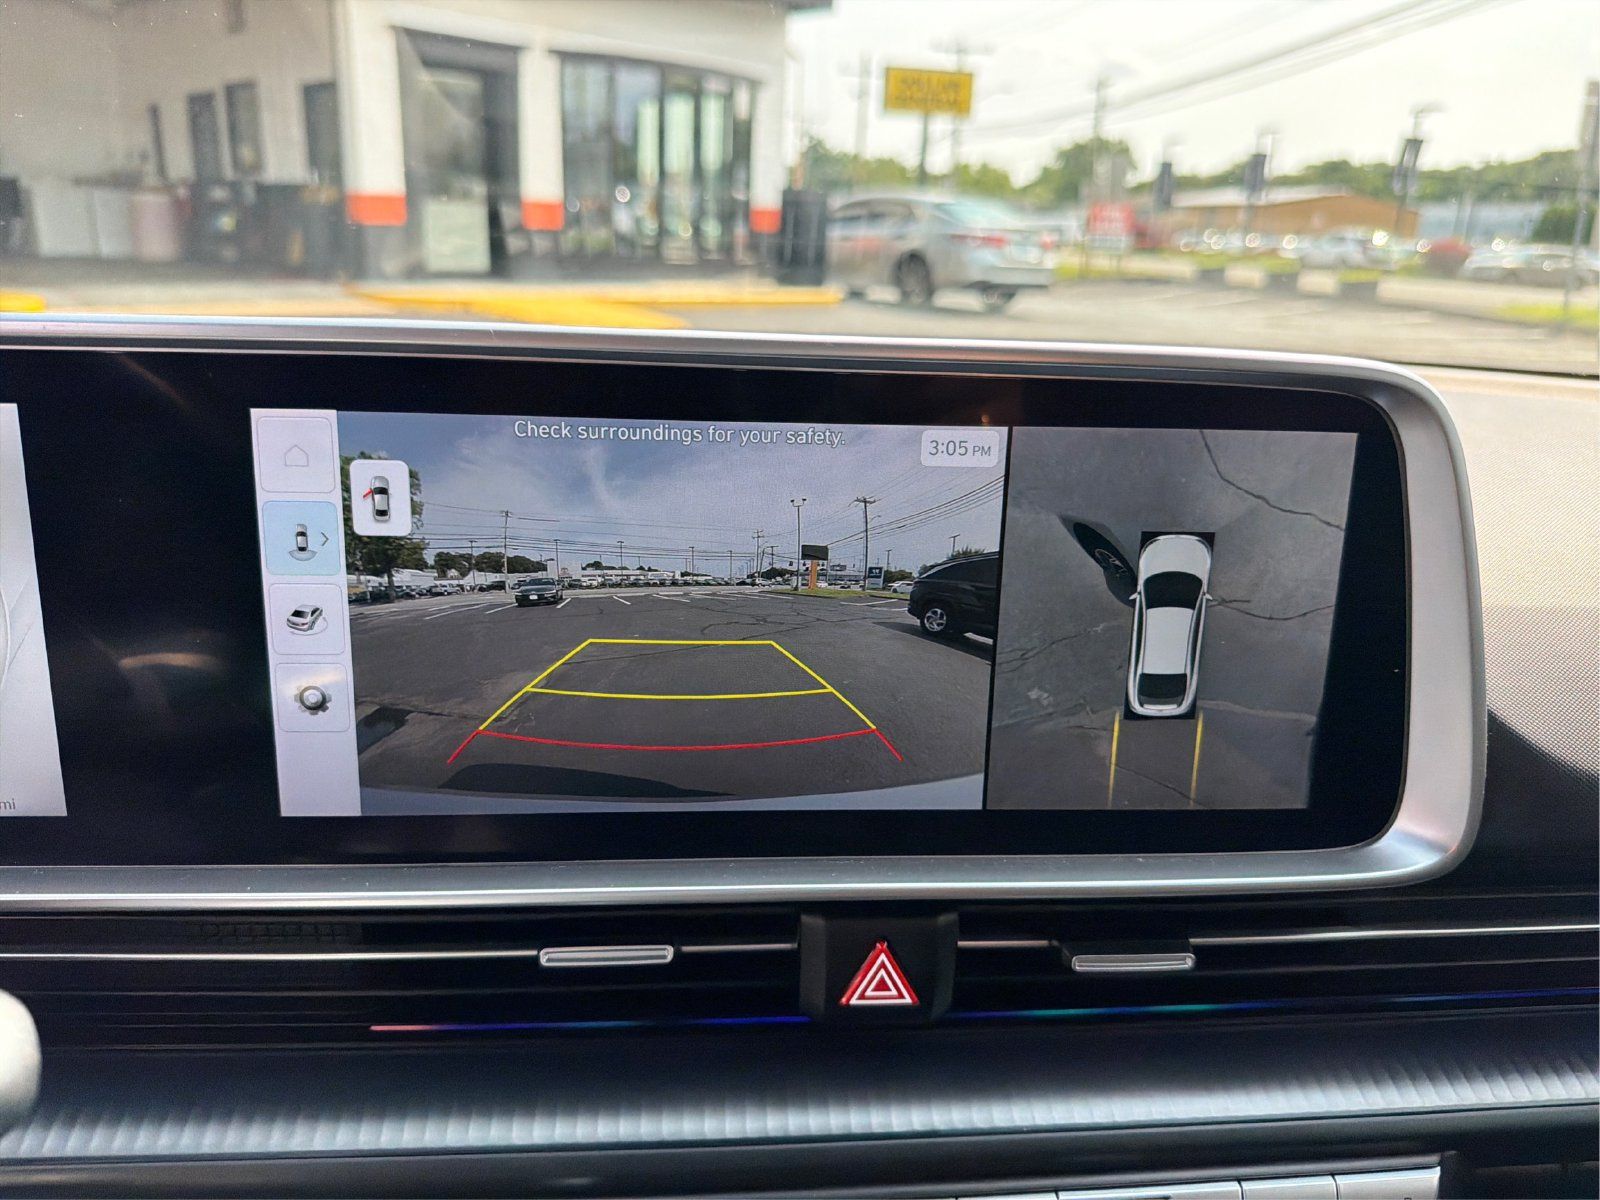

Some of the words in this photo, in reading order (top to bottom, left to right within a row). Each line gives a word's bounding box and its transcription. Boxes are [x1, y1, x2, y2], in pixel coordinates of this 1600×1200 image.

[514, 420, 572, 438] Check
[577, 424, 703, 445] surroundings
[707, 425, 735, 442] for
[739, 430, 783, 447] your
[786, 428, 846, 448] safety.
[928, 440, 969, 457] 3:05
[972, 446, 992, 457] PM
